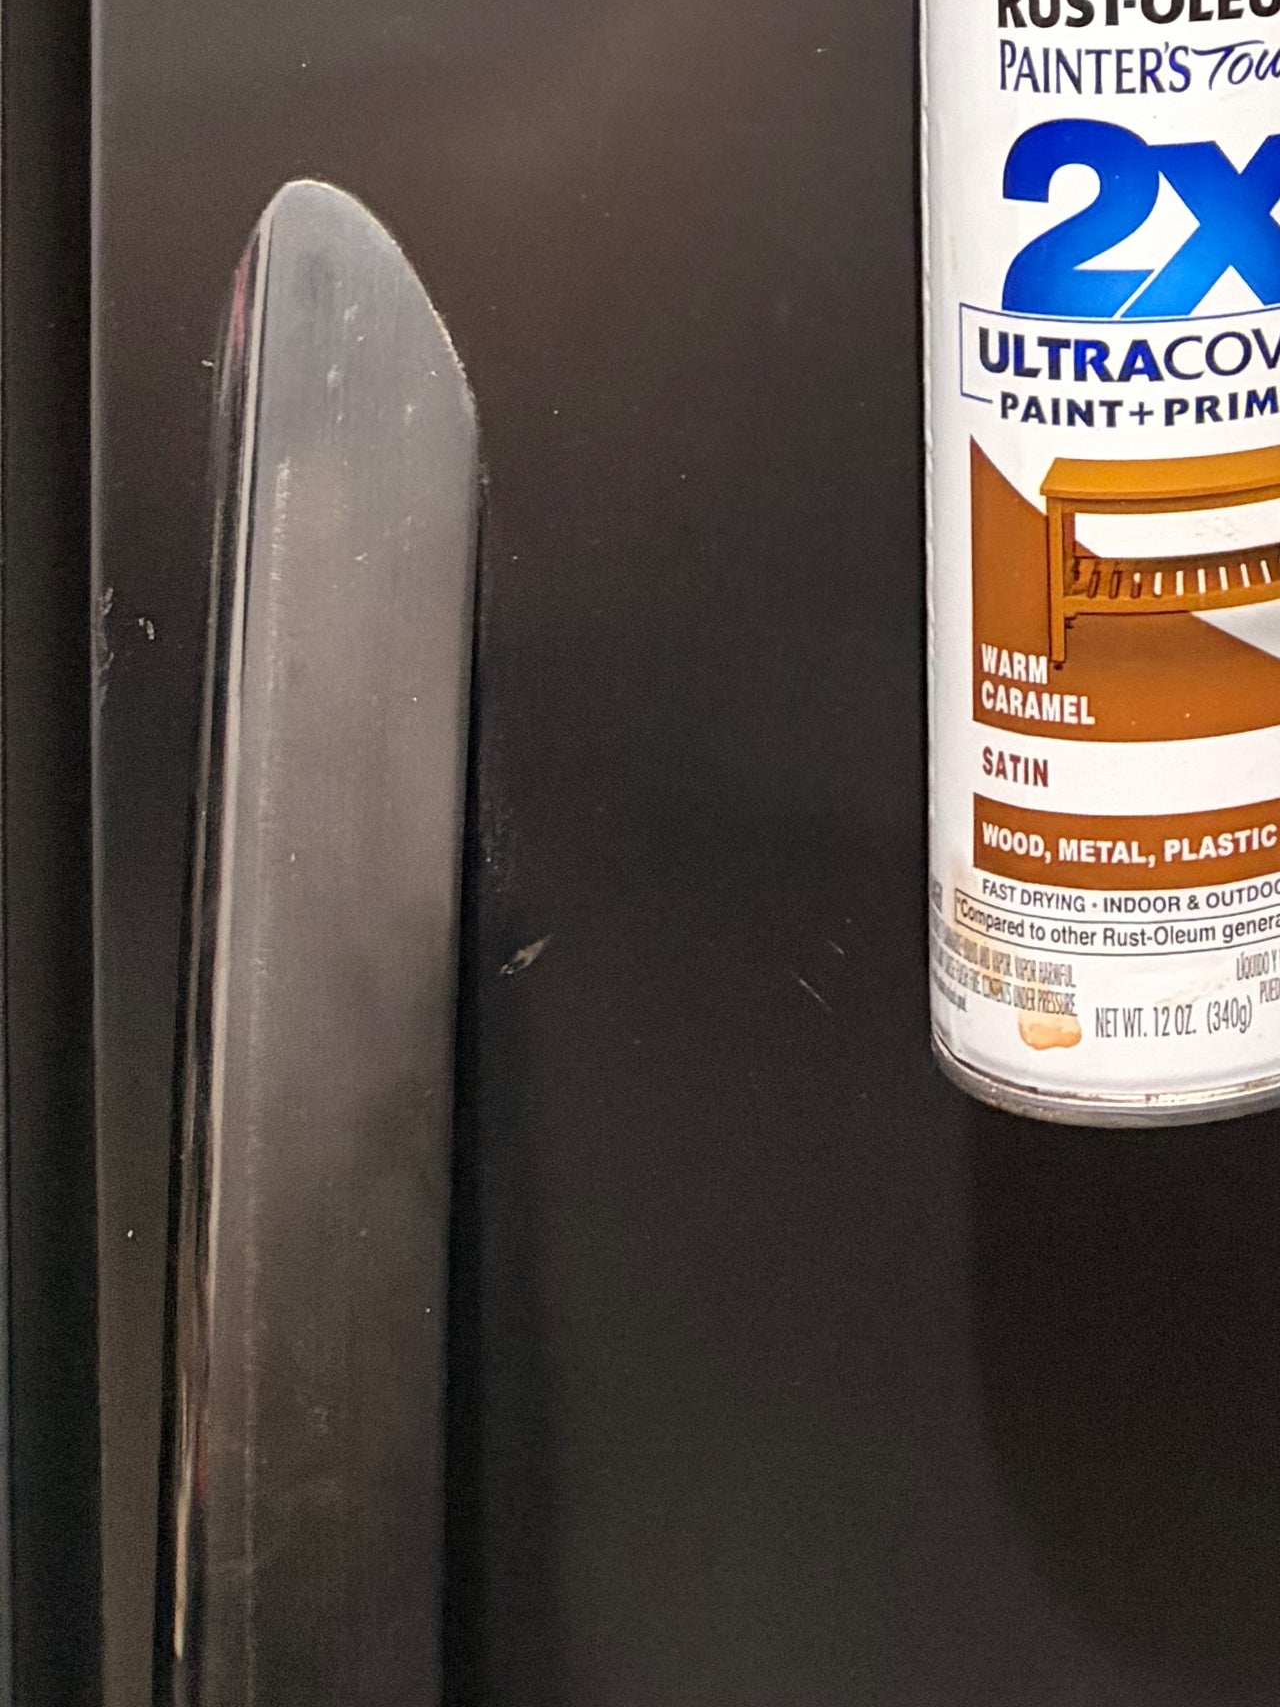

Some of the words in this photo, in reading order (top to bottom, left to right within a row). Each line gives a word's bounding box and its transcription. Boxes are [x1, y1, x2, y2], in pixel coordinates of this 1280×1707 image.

[999, 37, 1193, 96] PAINTER'S
[980, 642, 1049, 686] WARM
[980, 680, 1096, 726] CARAMEL
[982, 745, 1050, 788] SATIN
[982, 821, 1051, 865] WOOD,
[1058, 837, 1156, 869] METAL,
[1164, 823, 1278, 863] PLASTIC
[982, 877, 1017, 903] FAST
[1020, 890, 1086, 914] DRYING
[1103, 894, 1181, 914] INDOOR
[1186, 893, 1201, 912] &
[1029, 921, 1047, 939] to
[1050, 924, 1097, 947] other
[1102, 923, 1216, 948] Rust-Oleum
[1095, 1006, 1120, 1039] NET
[1122, 1006, 1148, 1039] WT.
[1153, 1005, 1171, 1038] 12
[1174, 1003, 1198, 1036] OZ.
[1205, 994, 1253, 1035] (340g)
